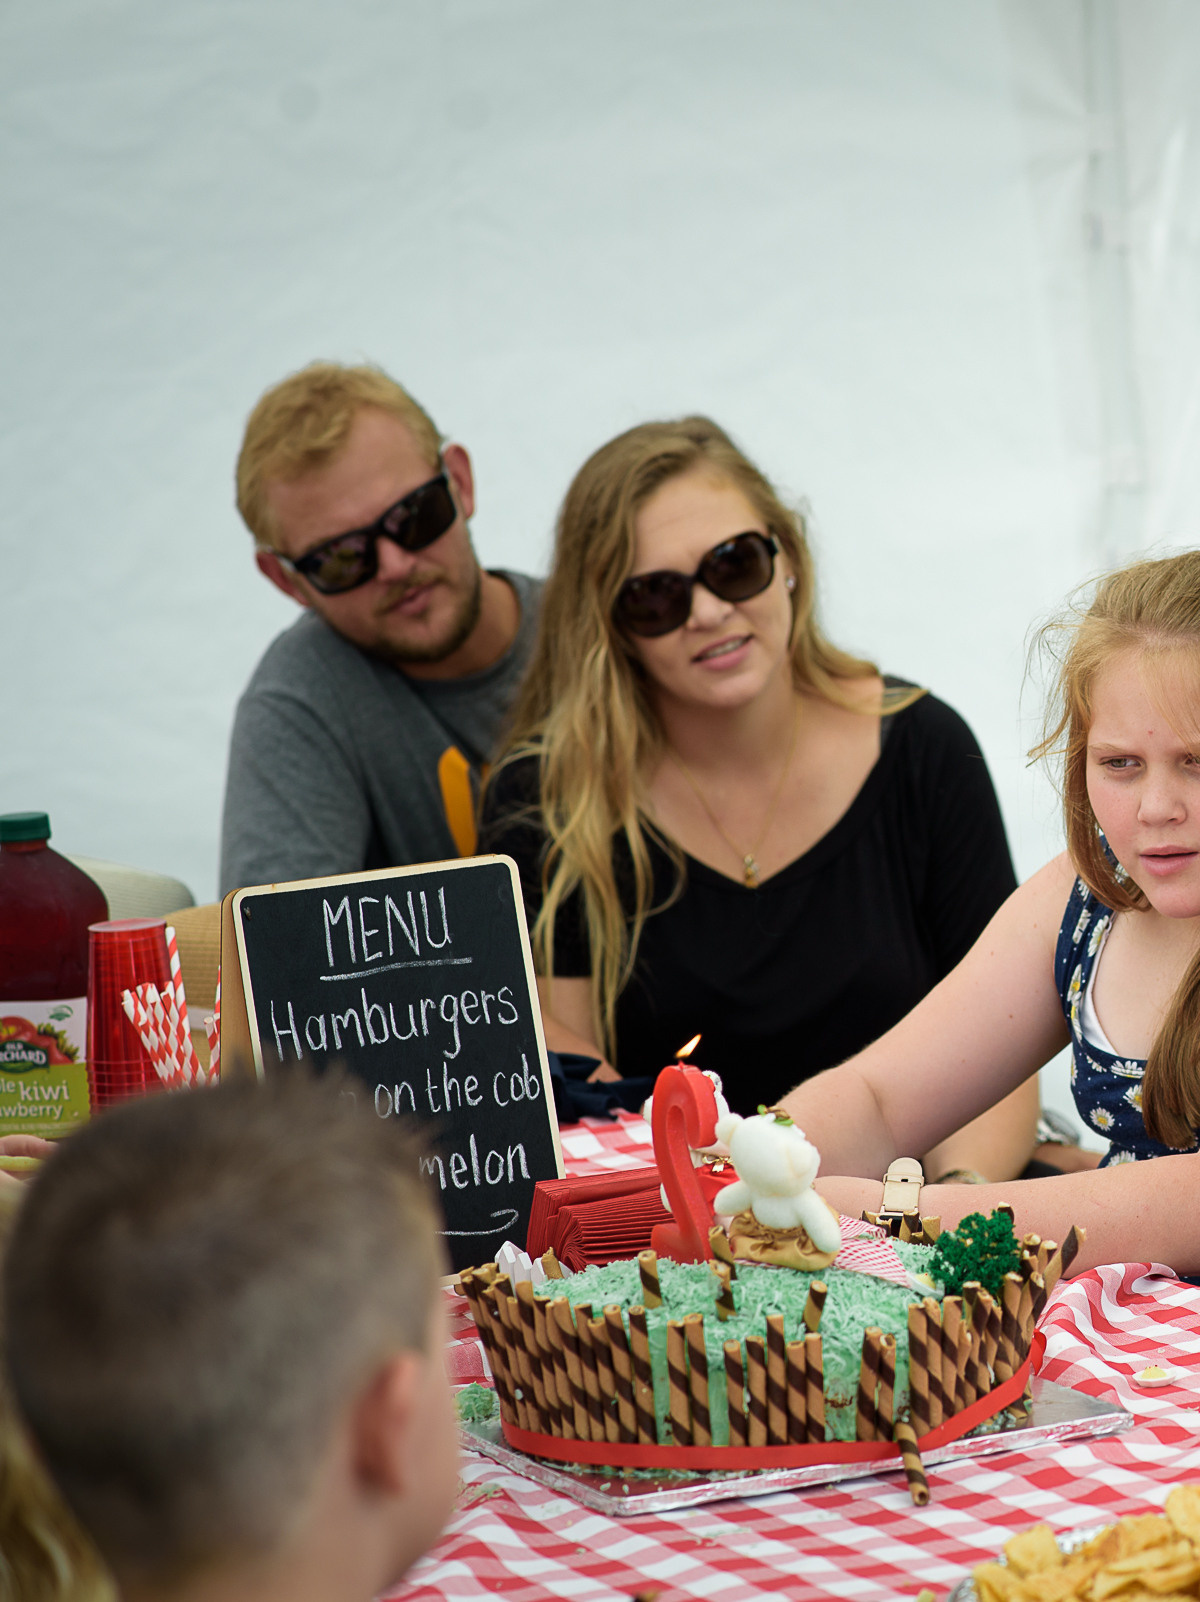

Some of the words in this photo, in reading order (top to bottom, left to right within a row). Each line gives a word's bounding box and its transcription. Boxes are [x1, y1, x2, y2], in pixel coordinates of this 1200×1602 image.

[322, 886, 453, 967] MENU
[270, 986, 519, 1062] Hamburgers
[0, 1078, 16, 1093] le
[19, 1080, 70, 1101] kiwi
[374, 1081, 417, 1119] on
[425, 1061, 483, 1113] the
[493, 1053, 541, 1107] cob
